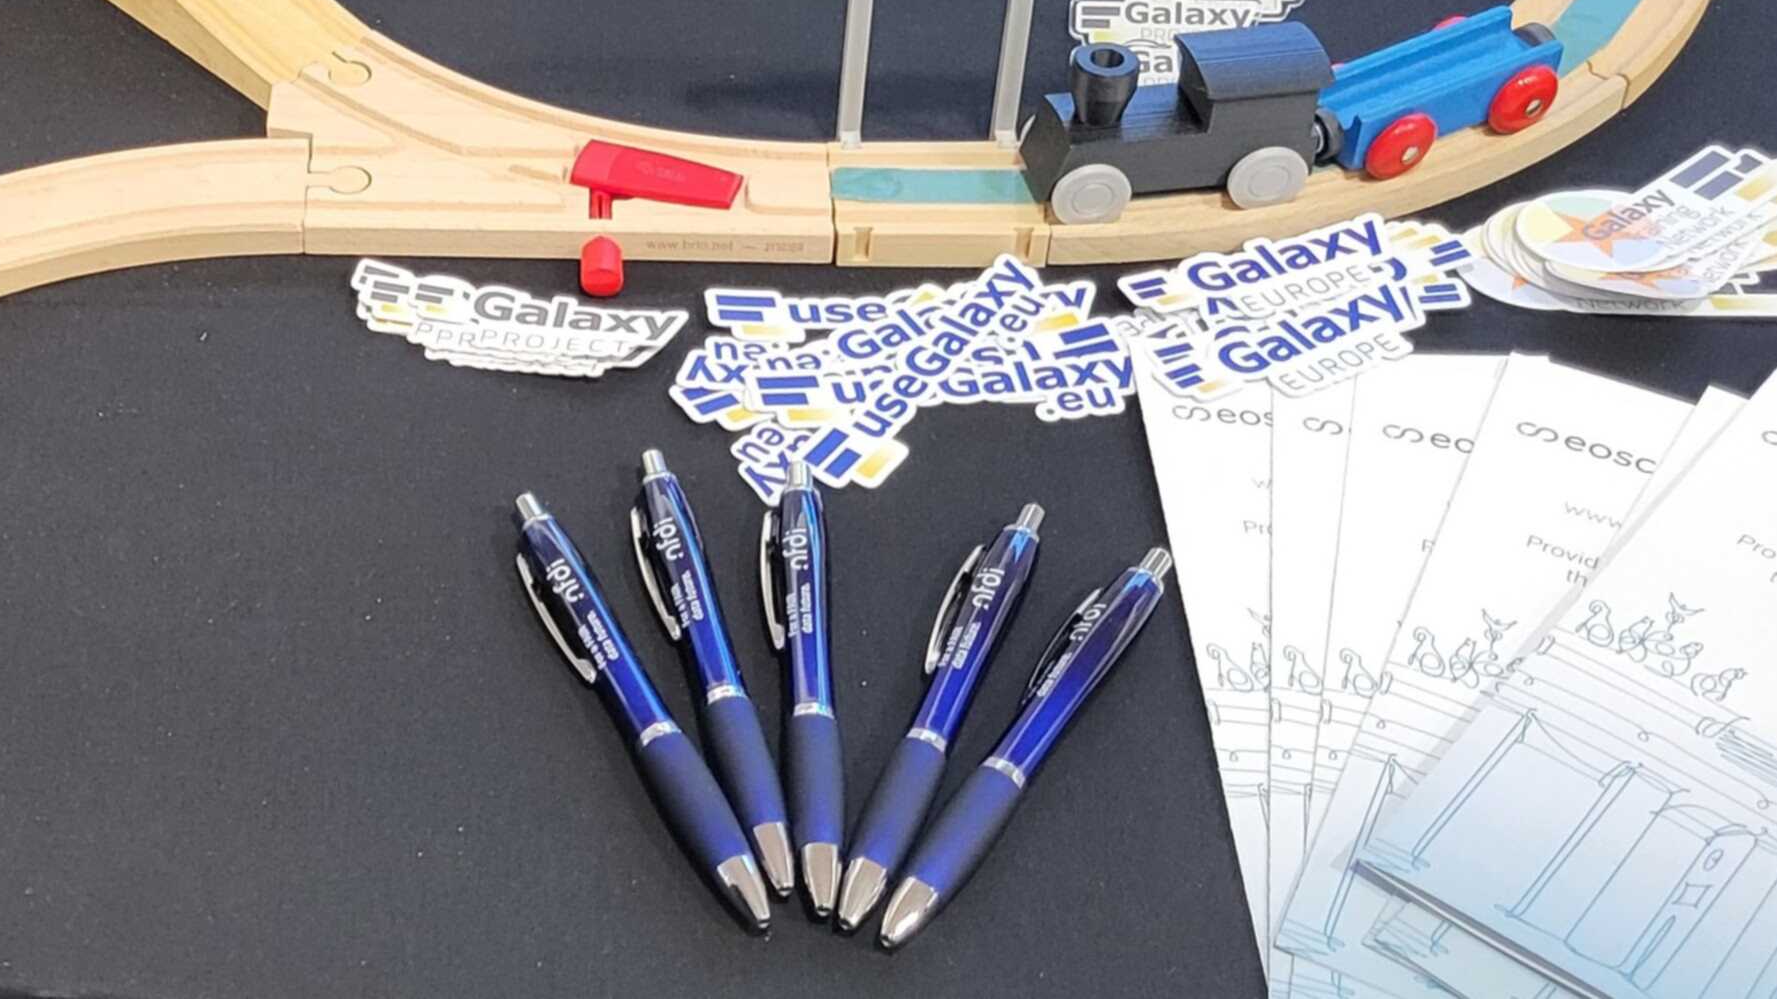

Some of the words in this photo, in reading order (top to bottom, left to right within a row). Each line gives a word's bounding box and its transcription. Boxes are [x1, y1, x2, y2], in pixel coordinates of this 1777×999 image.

[1125, 1, 1251, 29] Galaxy
[1583, 187, 1676, 240] Galaxy
[1187, 219, 1382, 292] Galaxy
[1240, 265, 1366, 314] EUROPE
[474, 290, 680, 341] Galaxy
[480, 328, 628, 353] PROJECT
[1218, 284, 1405, 374] Galaxy
[938, 355, 1133, 398] Galaxy
[1278, 332, 1401, 391] EUROPE
